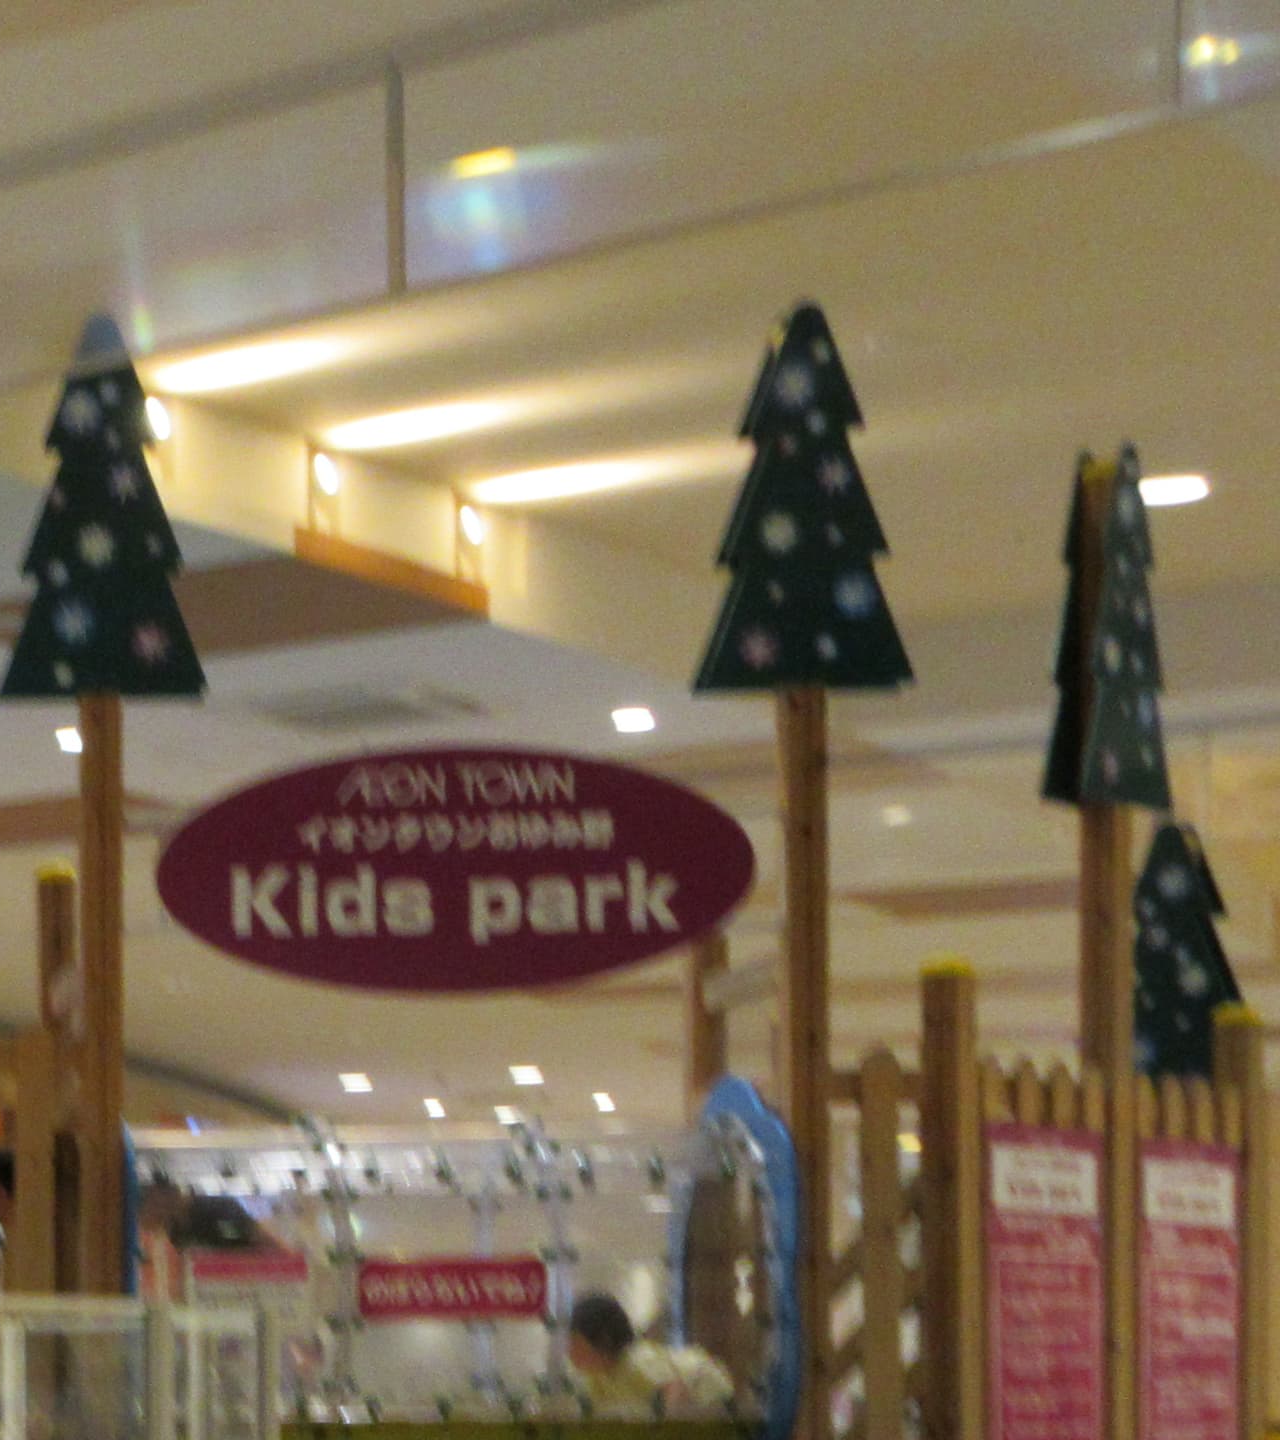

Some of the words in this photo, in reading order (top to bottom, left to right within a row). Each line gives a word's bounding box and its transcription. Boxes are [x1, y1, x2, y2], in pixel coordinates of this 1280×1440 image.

[456, 760, 576, 802] TOWN
[230, 862, 436, 939] Kids
[469, 860, 680, 945] park
